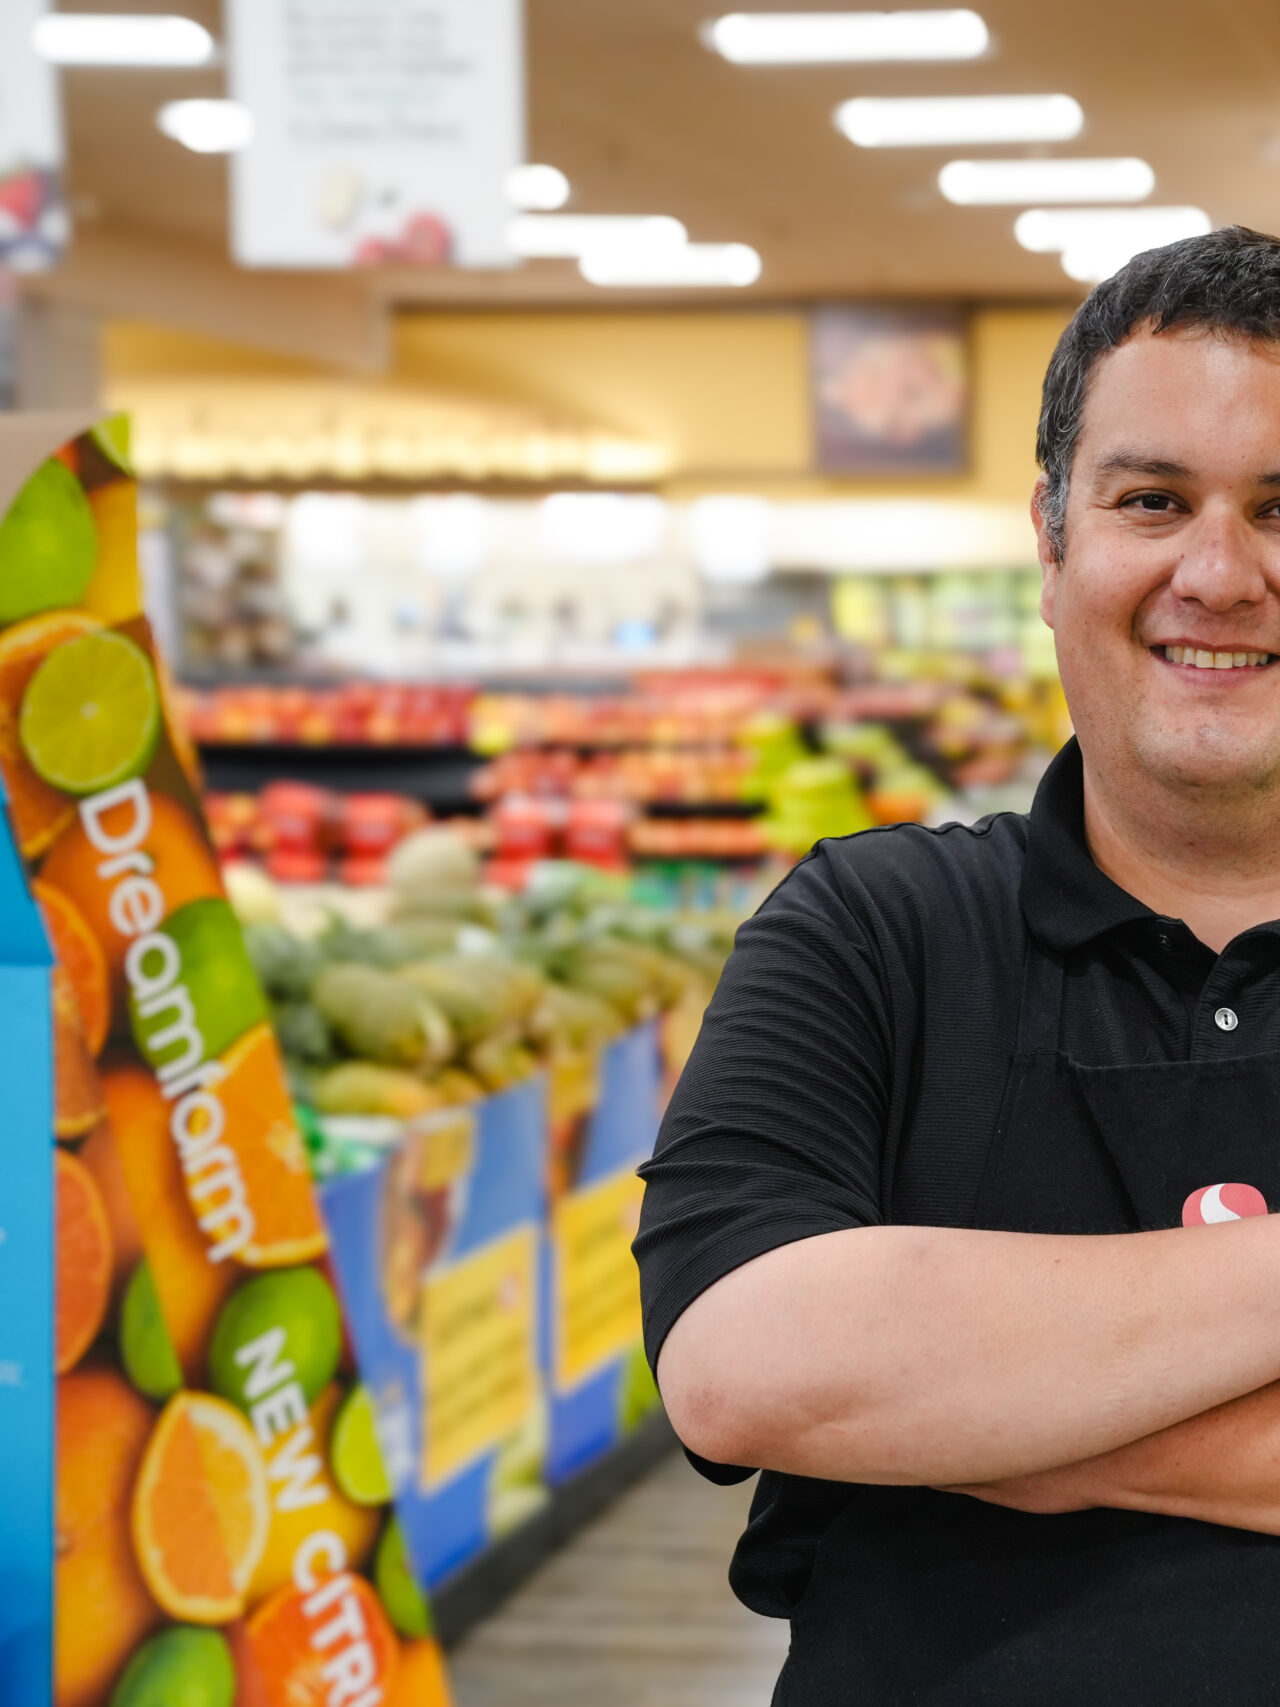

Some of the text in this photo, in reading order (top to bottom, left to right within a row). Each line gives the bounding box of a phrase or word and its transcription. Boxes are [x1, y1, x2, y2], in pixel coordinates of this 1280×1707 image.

[79, 777, 257, 1264] Dreamfarm
[234, 1325, 384, 1707] NEW CITR
